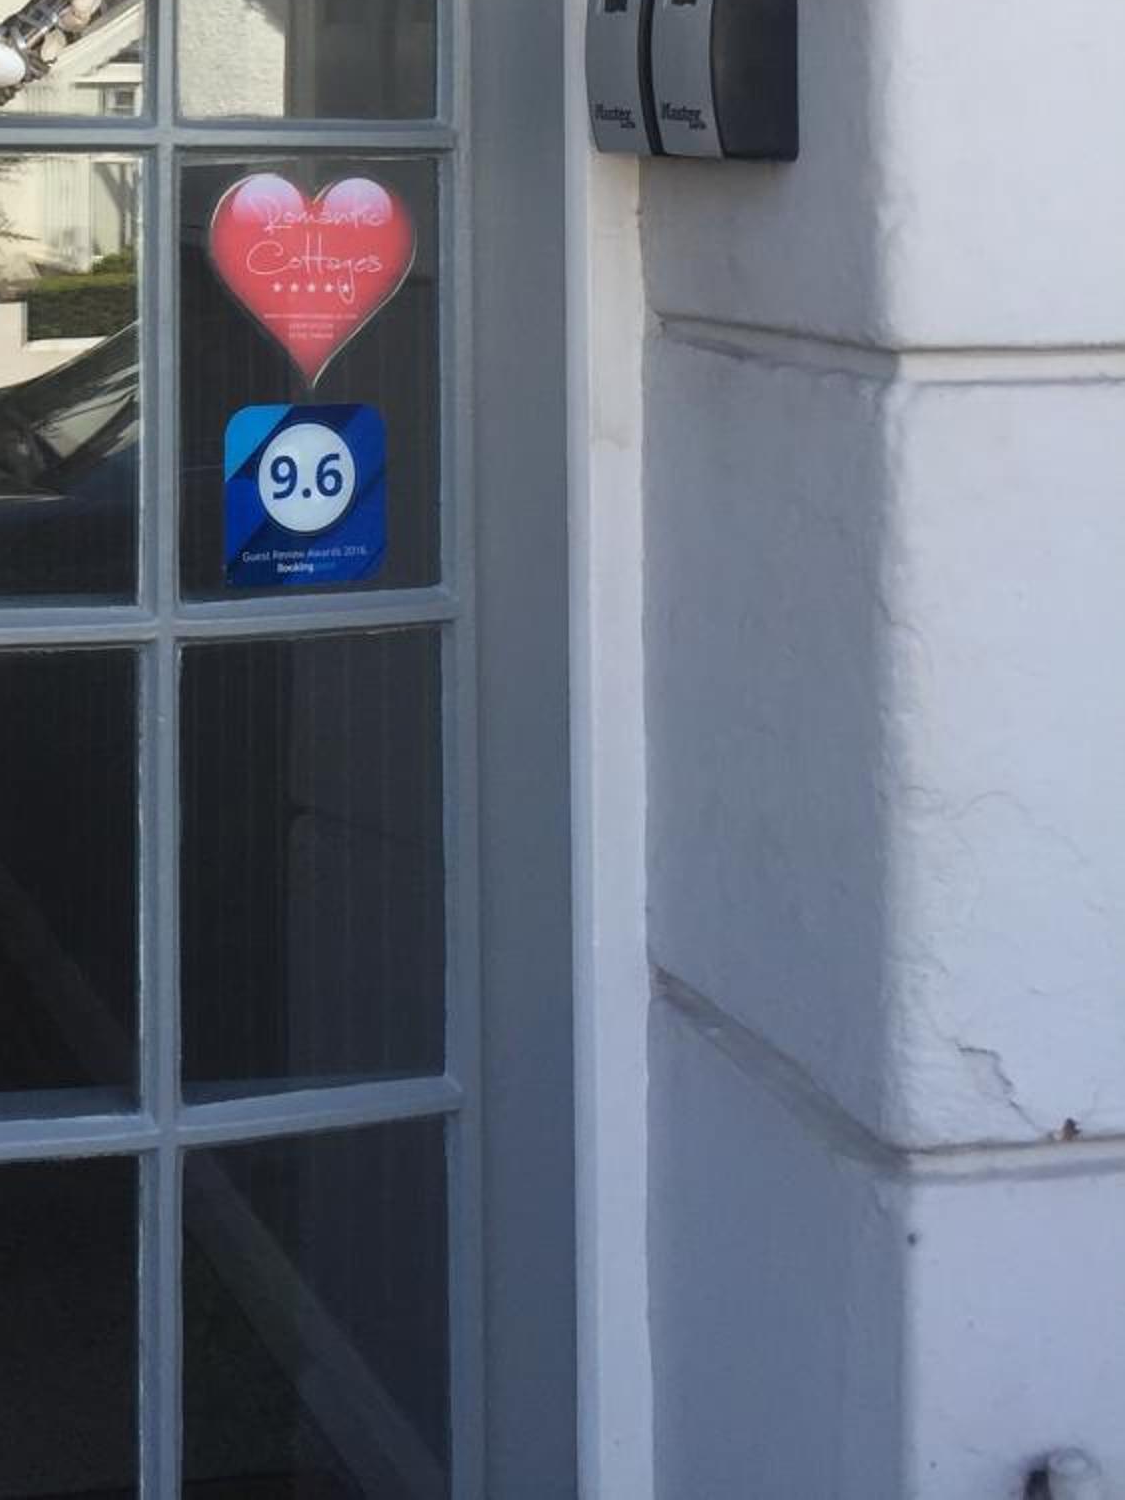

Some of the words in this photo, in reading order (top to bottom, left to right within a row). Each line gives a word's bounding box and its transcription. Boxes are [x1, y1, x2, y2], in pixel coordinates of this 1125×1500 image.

[246, 231, 383, 304] Cottages
[271, 453, 343, 500] 9.6
[242, 551, 270, 563] Guest
